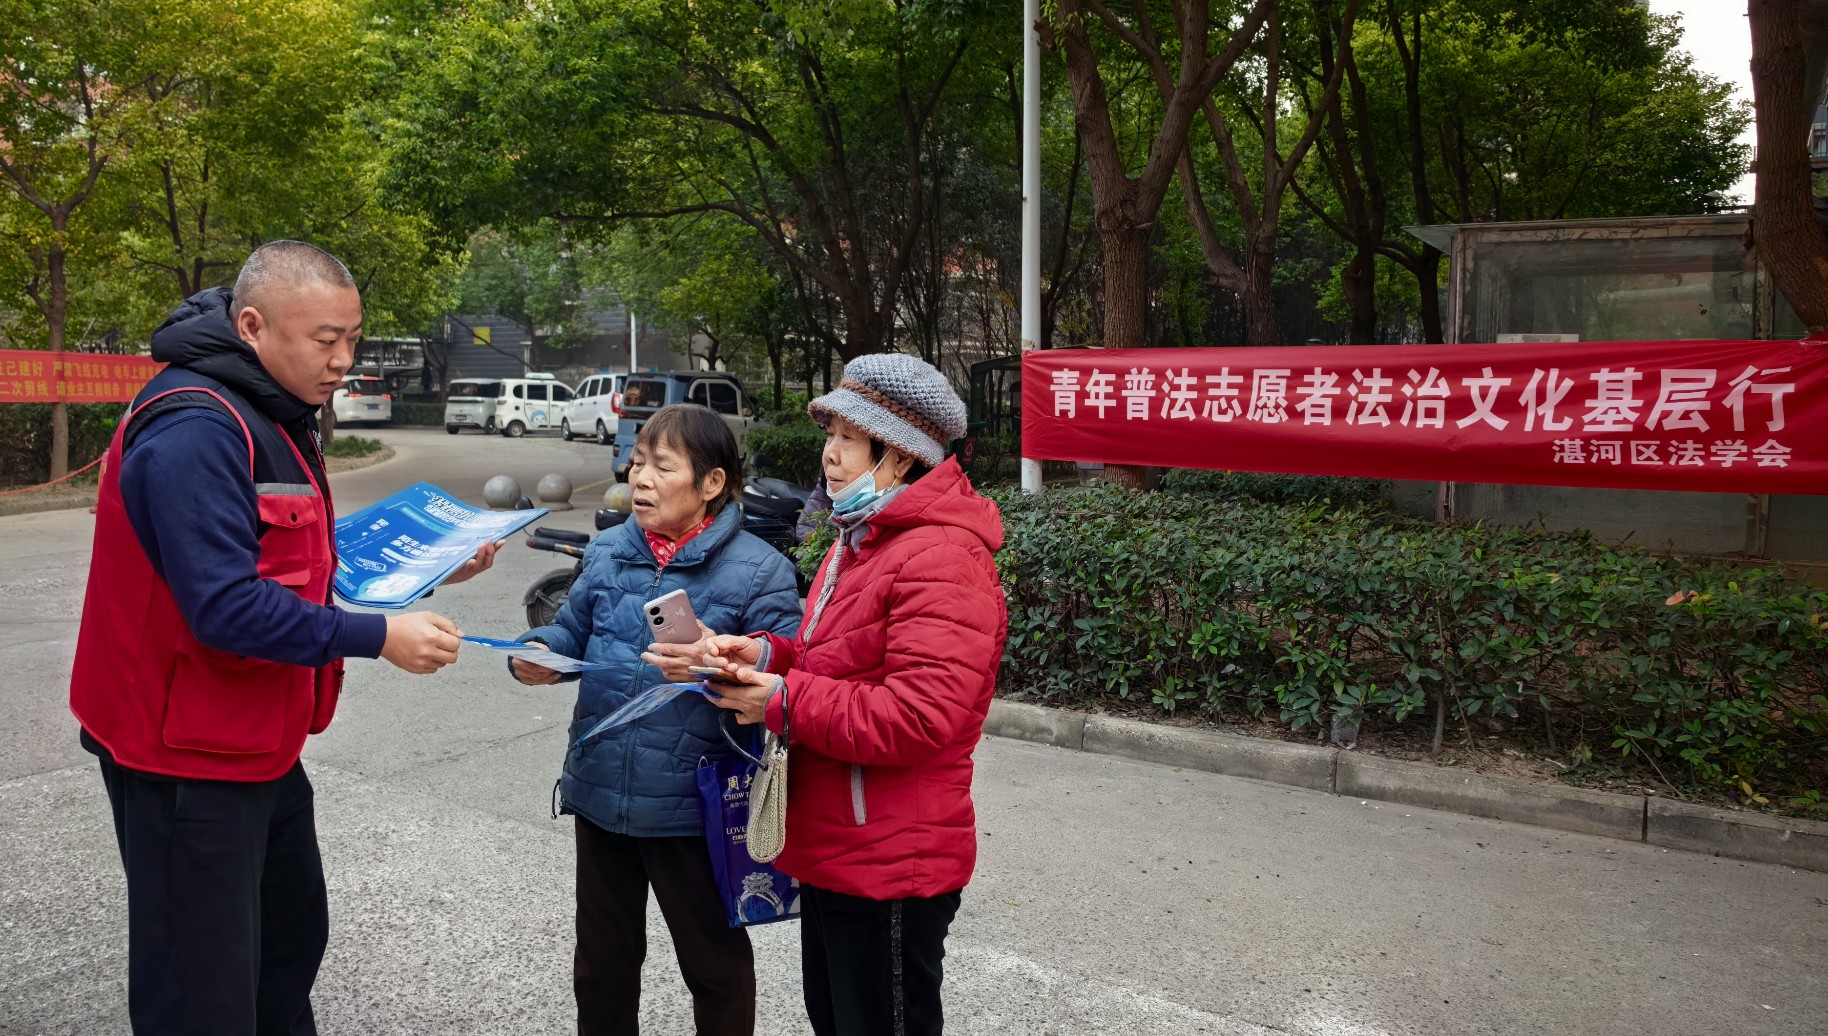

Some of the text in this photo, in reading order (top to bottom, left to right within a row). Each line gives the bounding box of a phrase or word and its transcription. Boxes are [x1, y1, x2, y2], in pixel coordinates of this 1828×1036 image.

[1050, 365, 1795, 432] 青年普法志愿者法治文化基层行
[1553, 438, 1791, 468] 湛河区法学会
[724, 792, 745, 801] CHOW
